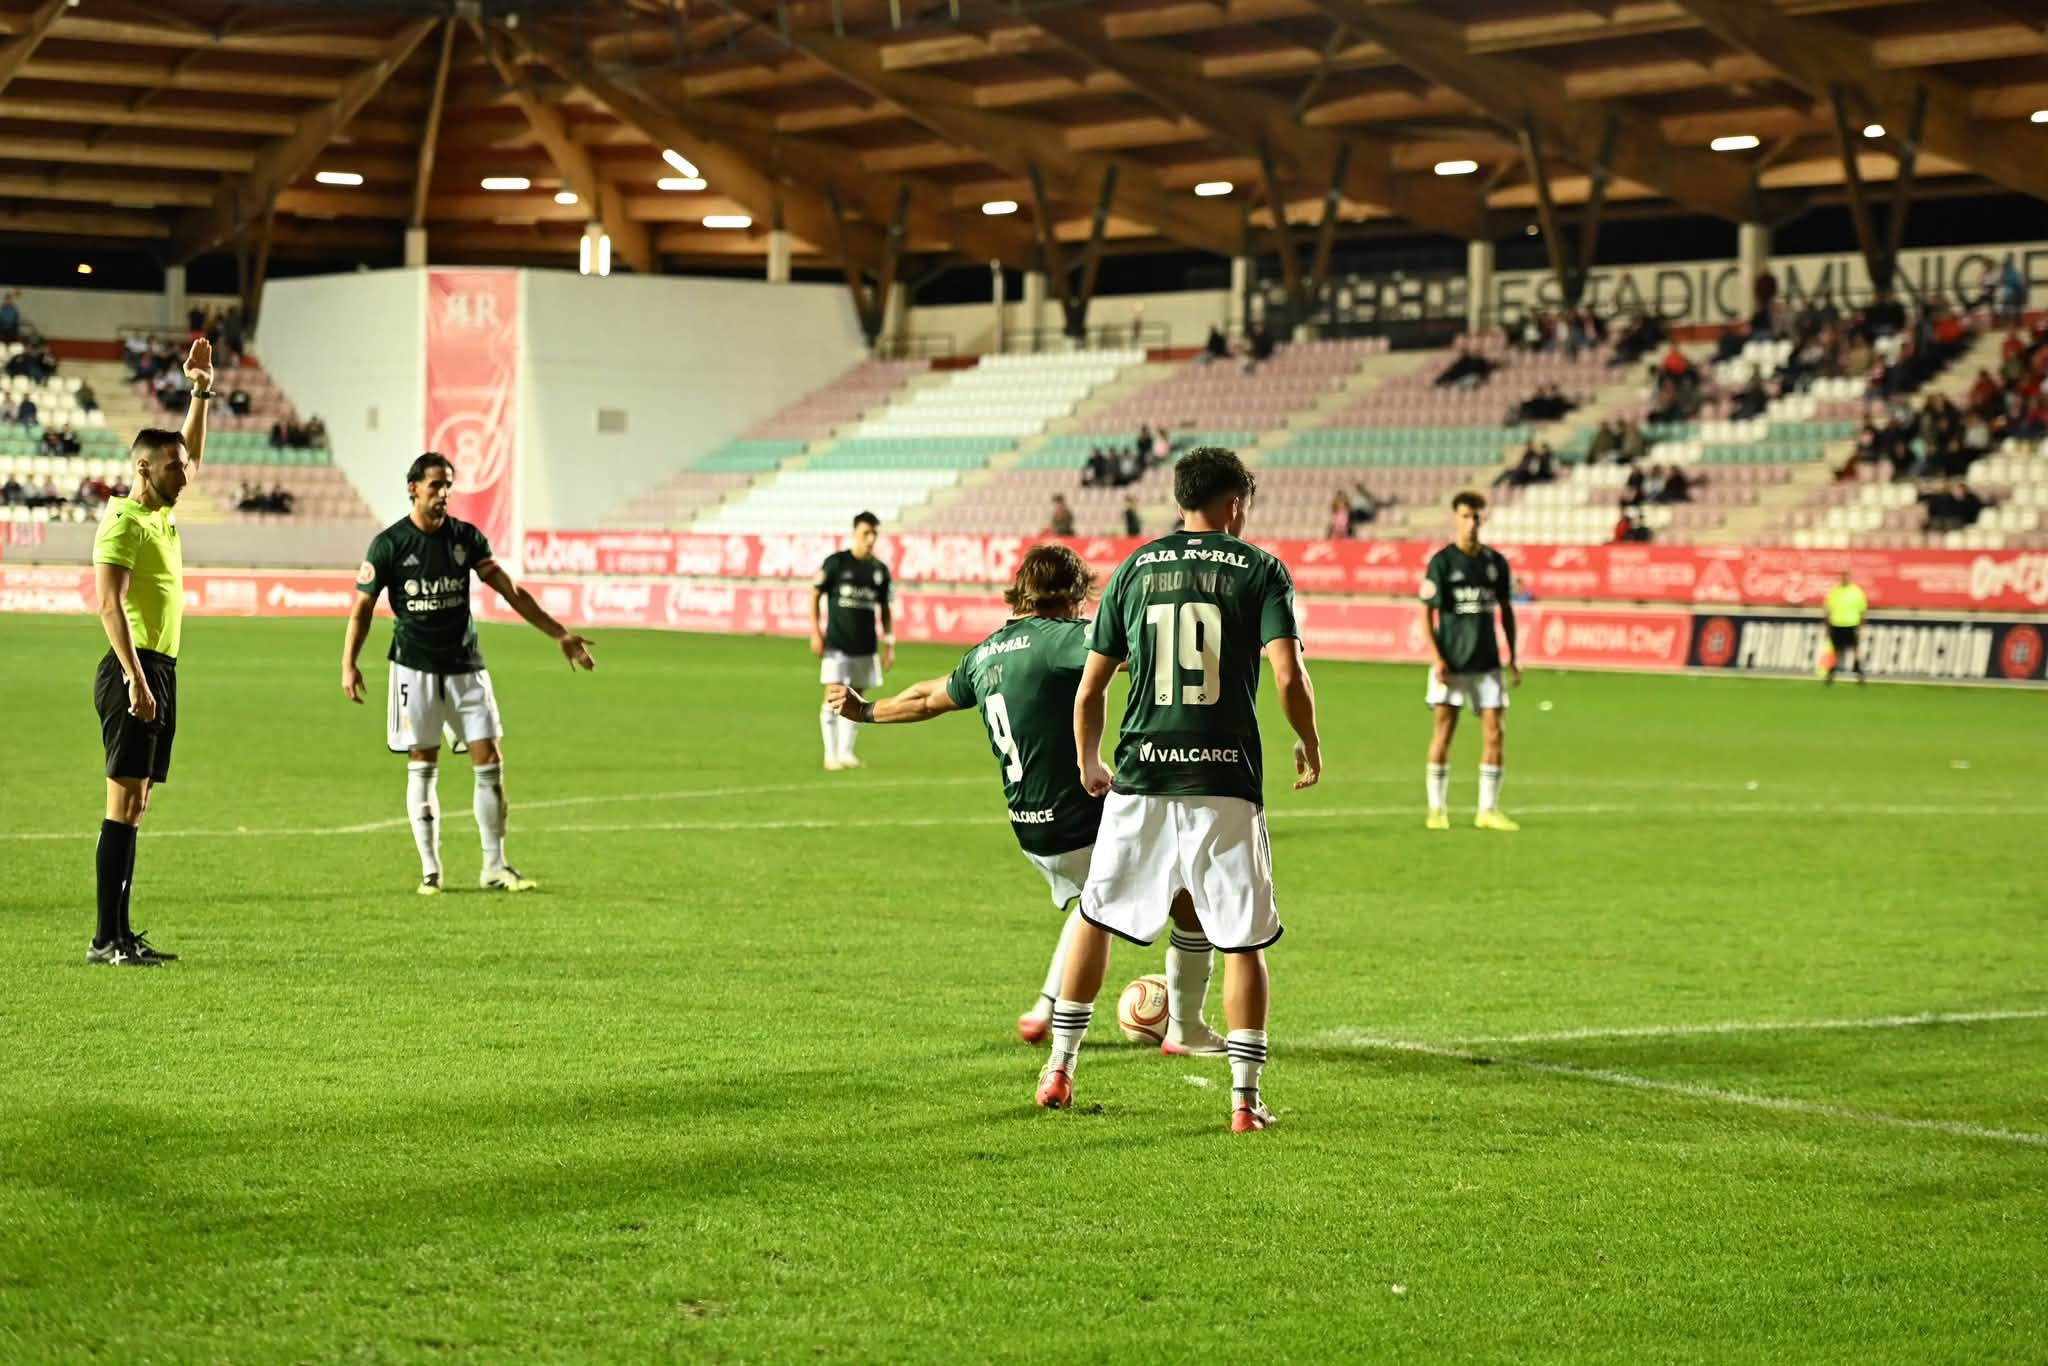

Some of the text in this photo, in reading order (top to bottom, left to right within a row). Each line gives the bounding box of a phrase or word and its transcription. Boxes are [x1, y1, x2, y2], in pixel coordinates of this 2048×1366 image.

[1135, 550, 1179, 567] CAJA
[406, 596, 465, 612] CRICU
[1146, 602, 1222, 705] 19
[401, 684, 409, 707] 5
[985, 692, 1024, 782] 9
[1156, 749, 1239, 763] VALCARCE
